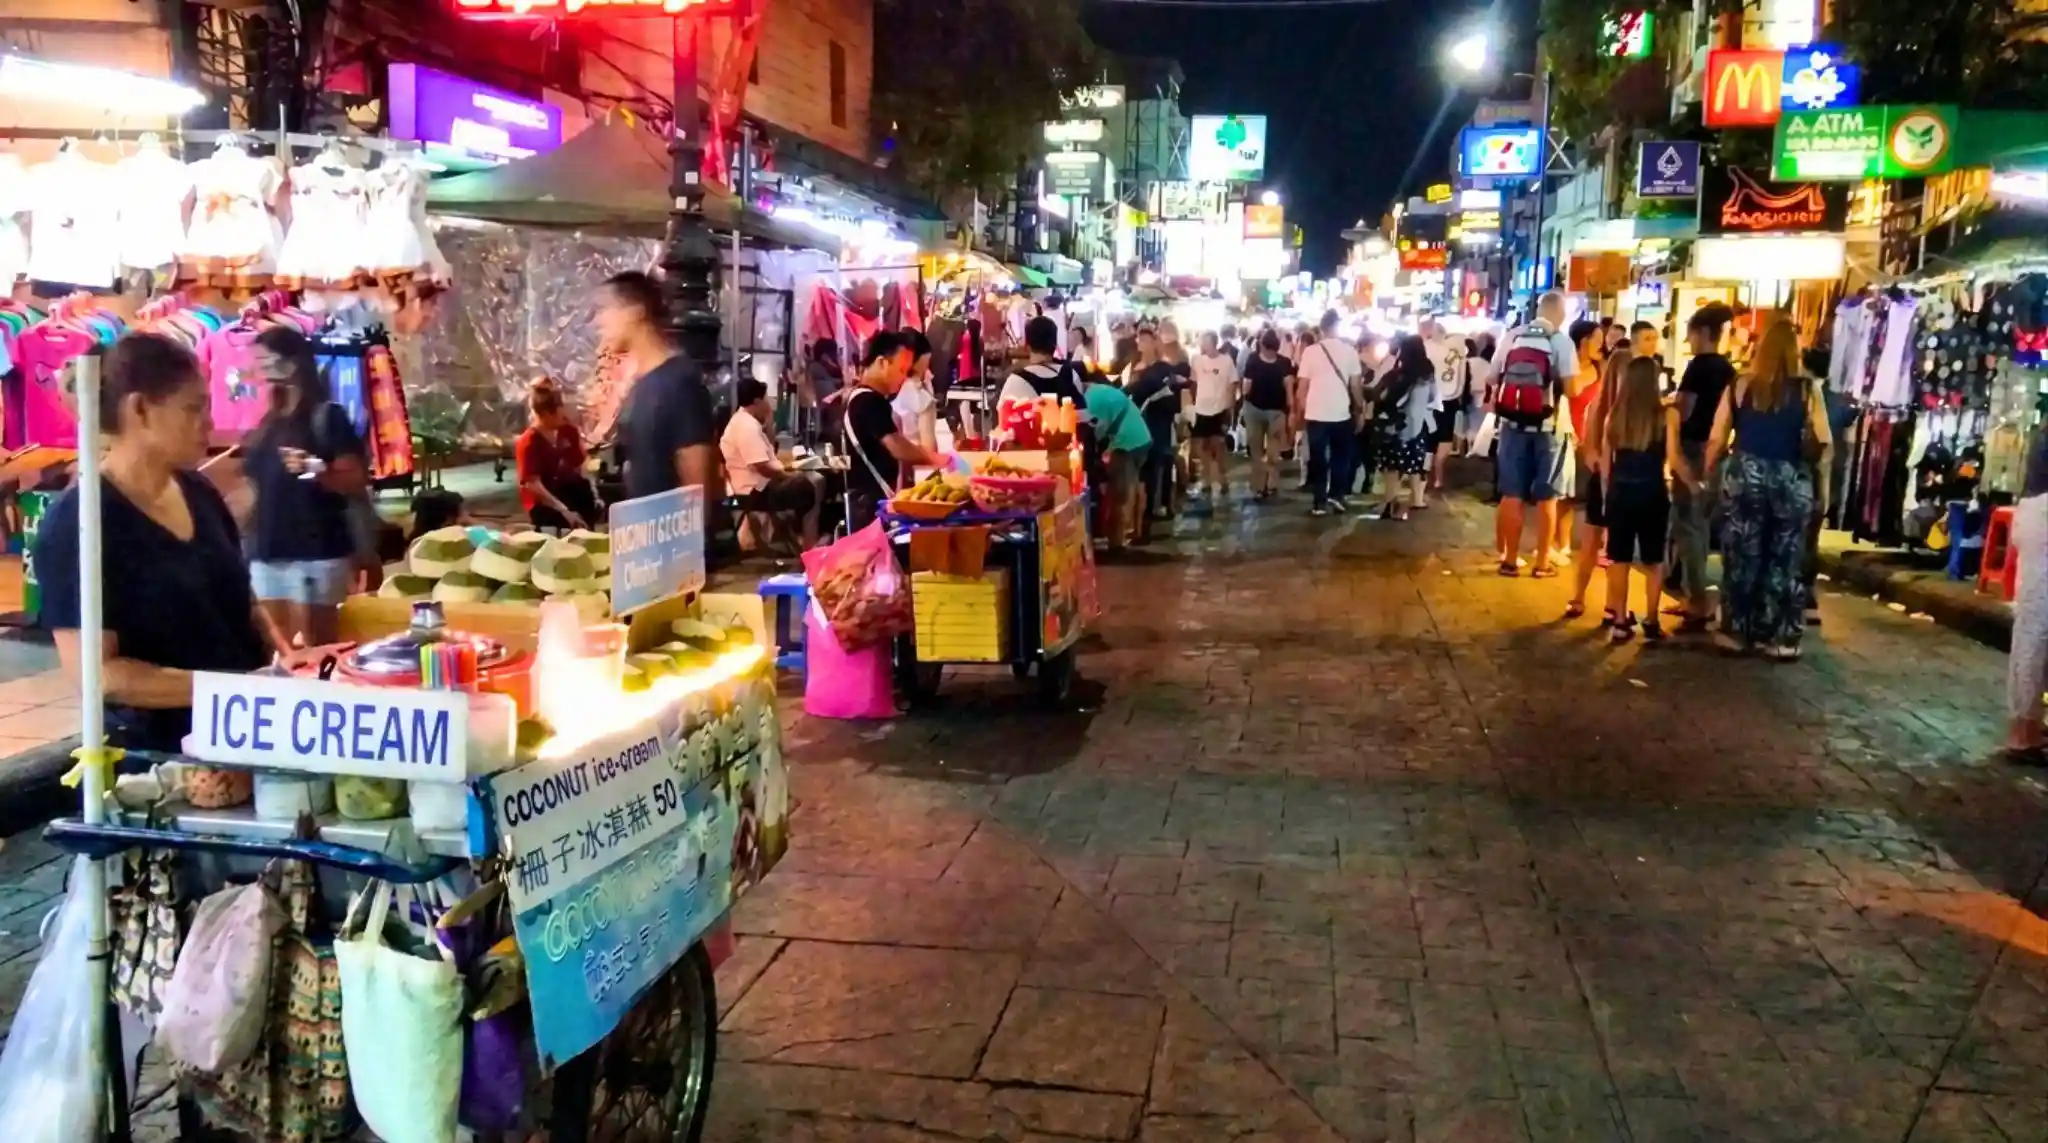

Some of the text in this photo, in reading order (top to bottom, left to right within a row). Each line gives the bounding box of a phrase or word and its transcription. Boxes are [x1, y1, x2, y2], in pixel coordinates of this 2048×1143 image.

[1812, 112, 1865, 134] ATM
[210, 693, 450, 767] ICE CREAM
[503, 761, 590, 828] COCONUT
[591, 735, 663, 787] ice-cream
[652, 777, 678, 817] 50
